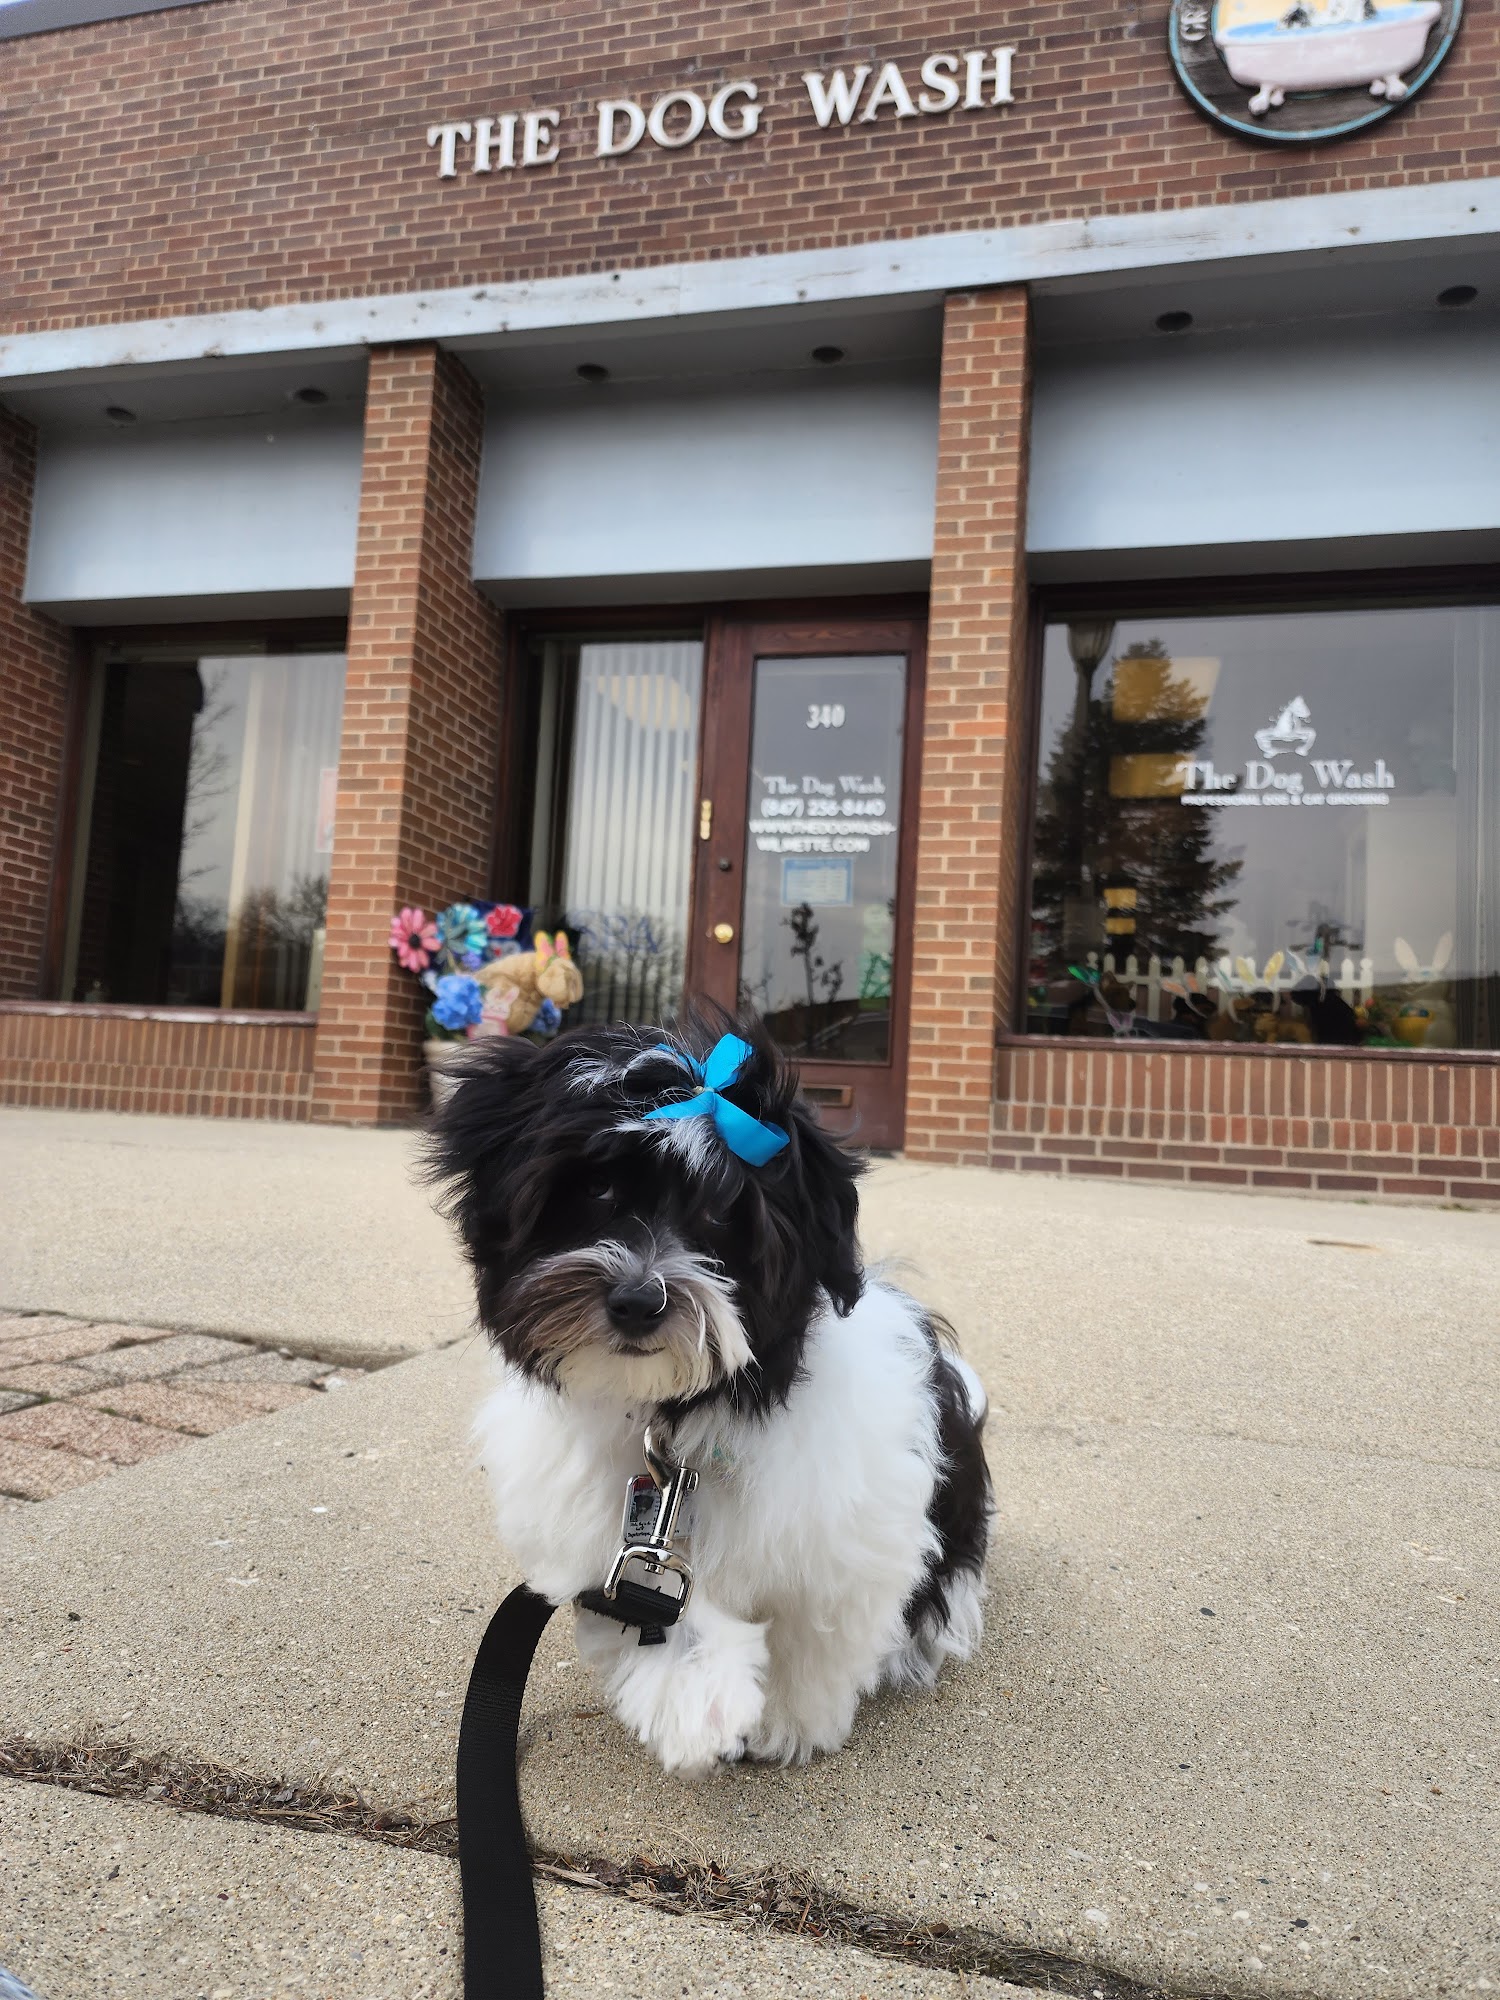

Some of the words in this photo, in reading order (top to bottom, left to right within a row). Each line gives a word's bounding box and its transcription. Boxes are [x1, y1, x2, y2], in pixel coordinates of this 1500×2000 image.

[427, 110, 561, 179] THE
[595, 81, 763, 158] DOG
[802, 46, 1017, 129] WASH
[806, 704, 845, 729] 340
[763, 776, 798, 795] The
[802, 776, 835, 798] Dog
[839, 776, 886, 795] Wash
[1176, 760, 1238, 790] The
[1245, 760, 1304, 795] Dog
[1311, 759, 1396, 789] Wash
[761, 798, 804, 818] (847)
